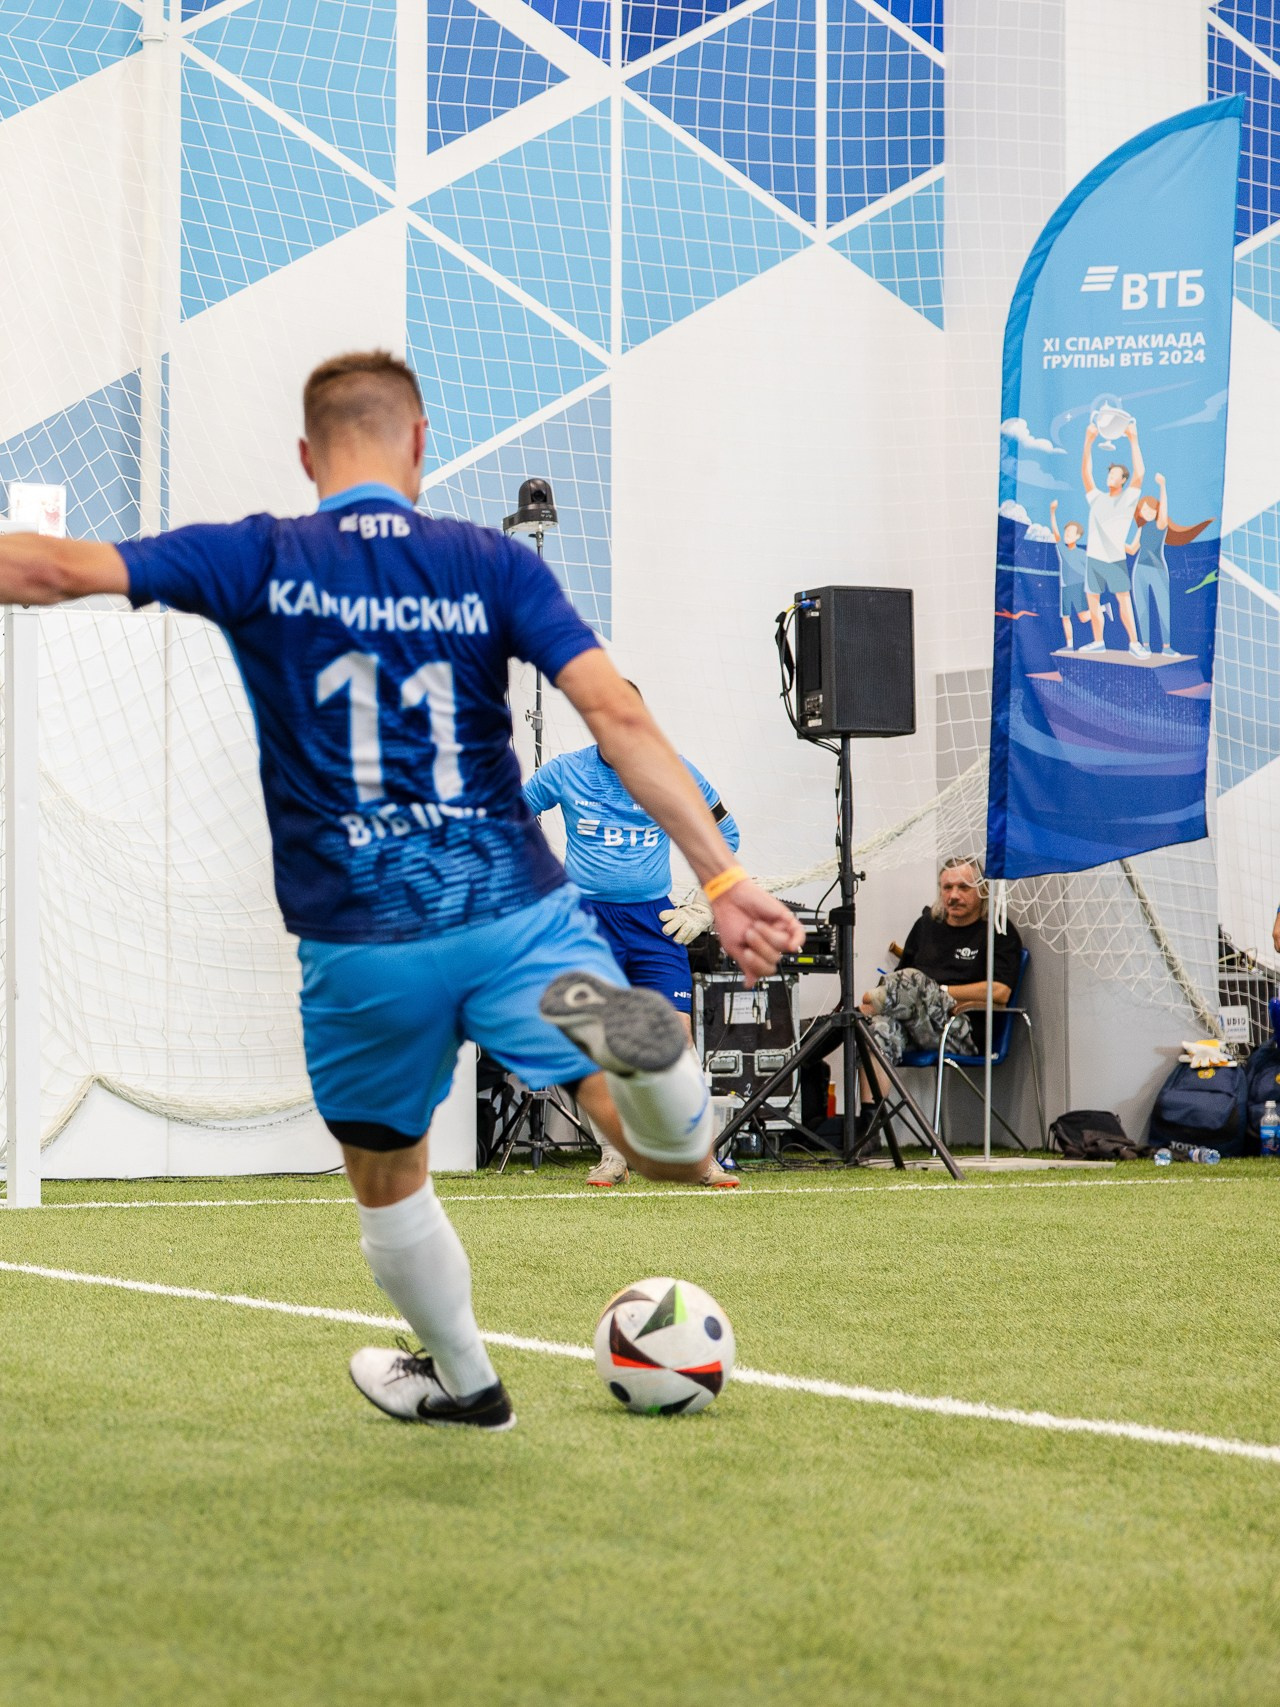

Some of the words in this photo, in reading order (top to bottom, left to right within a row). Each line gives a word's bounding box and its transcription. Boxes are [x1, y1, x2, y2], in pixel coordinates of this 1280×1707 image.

[1121, 269, 1205, 310] ВТБ
[1043, 338, 1060, 352] XI
[1065, 332, 1206, 352] СПАРТАКИАДА
[1043, 352, 1114, 369] ГРУППЫ
[1119, 351, 1154, 367] ВТБ
[1159, 349, 1206, 365] 2024
[359, 512, 411, 540] ВТБ
[315, 650, 465, 802] 11
[603, 826, 660, 847] ВТБ
